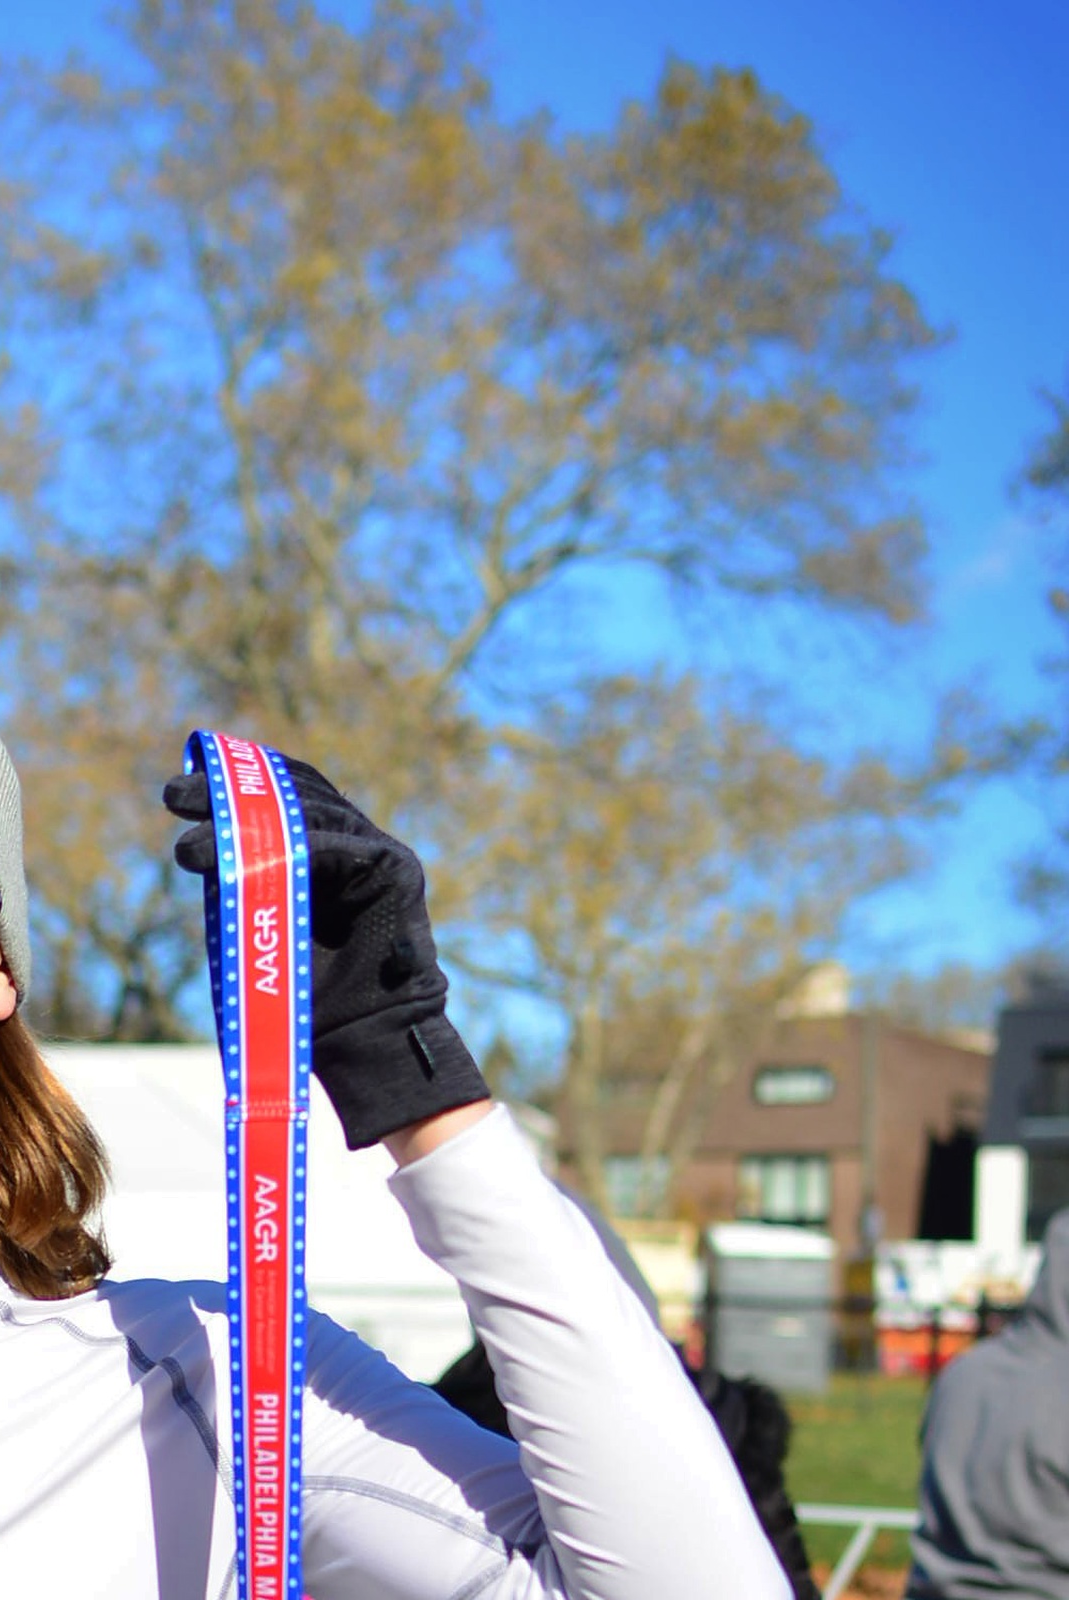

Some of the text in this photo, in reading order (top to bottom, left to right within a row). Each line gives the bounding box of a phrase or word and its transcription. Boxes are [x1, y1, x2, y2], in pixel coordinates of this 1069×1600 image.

[253, 905, 279, 996] AACR
[253, 1174, 279, 1264] AACR
[253, 1393, 279, 1567] PHILADELPHIA
